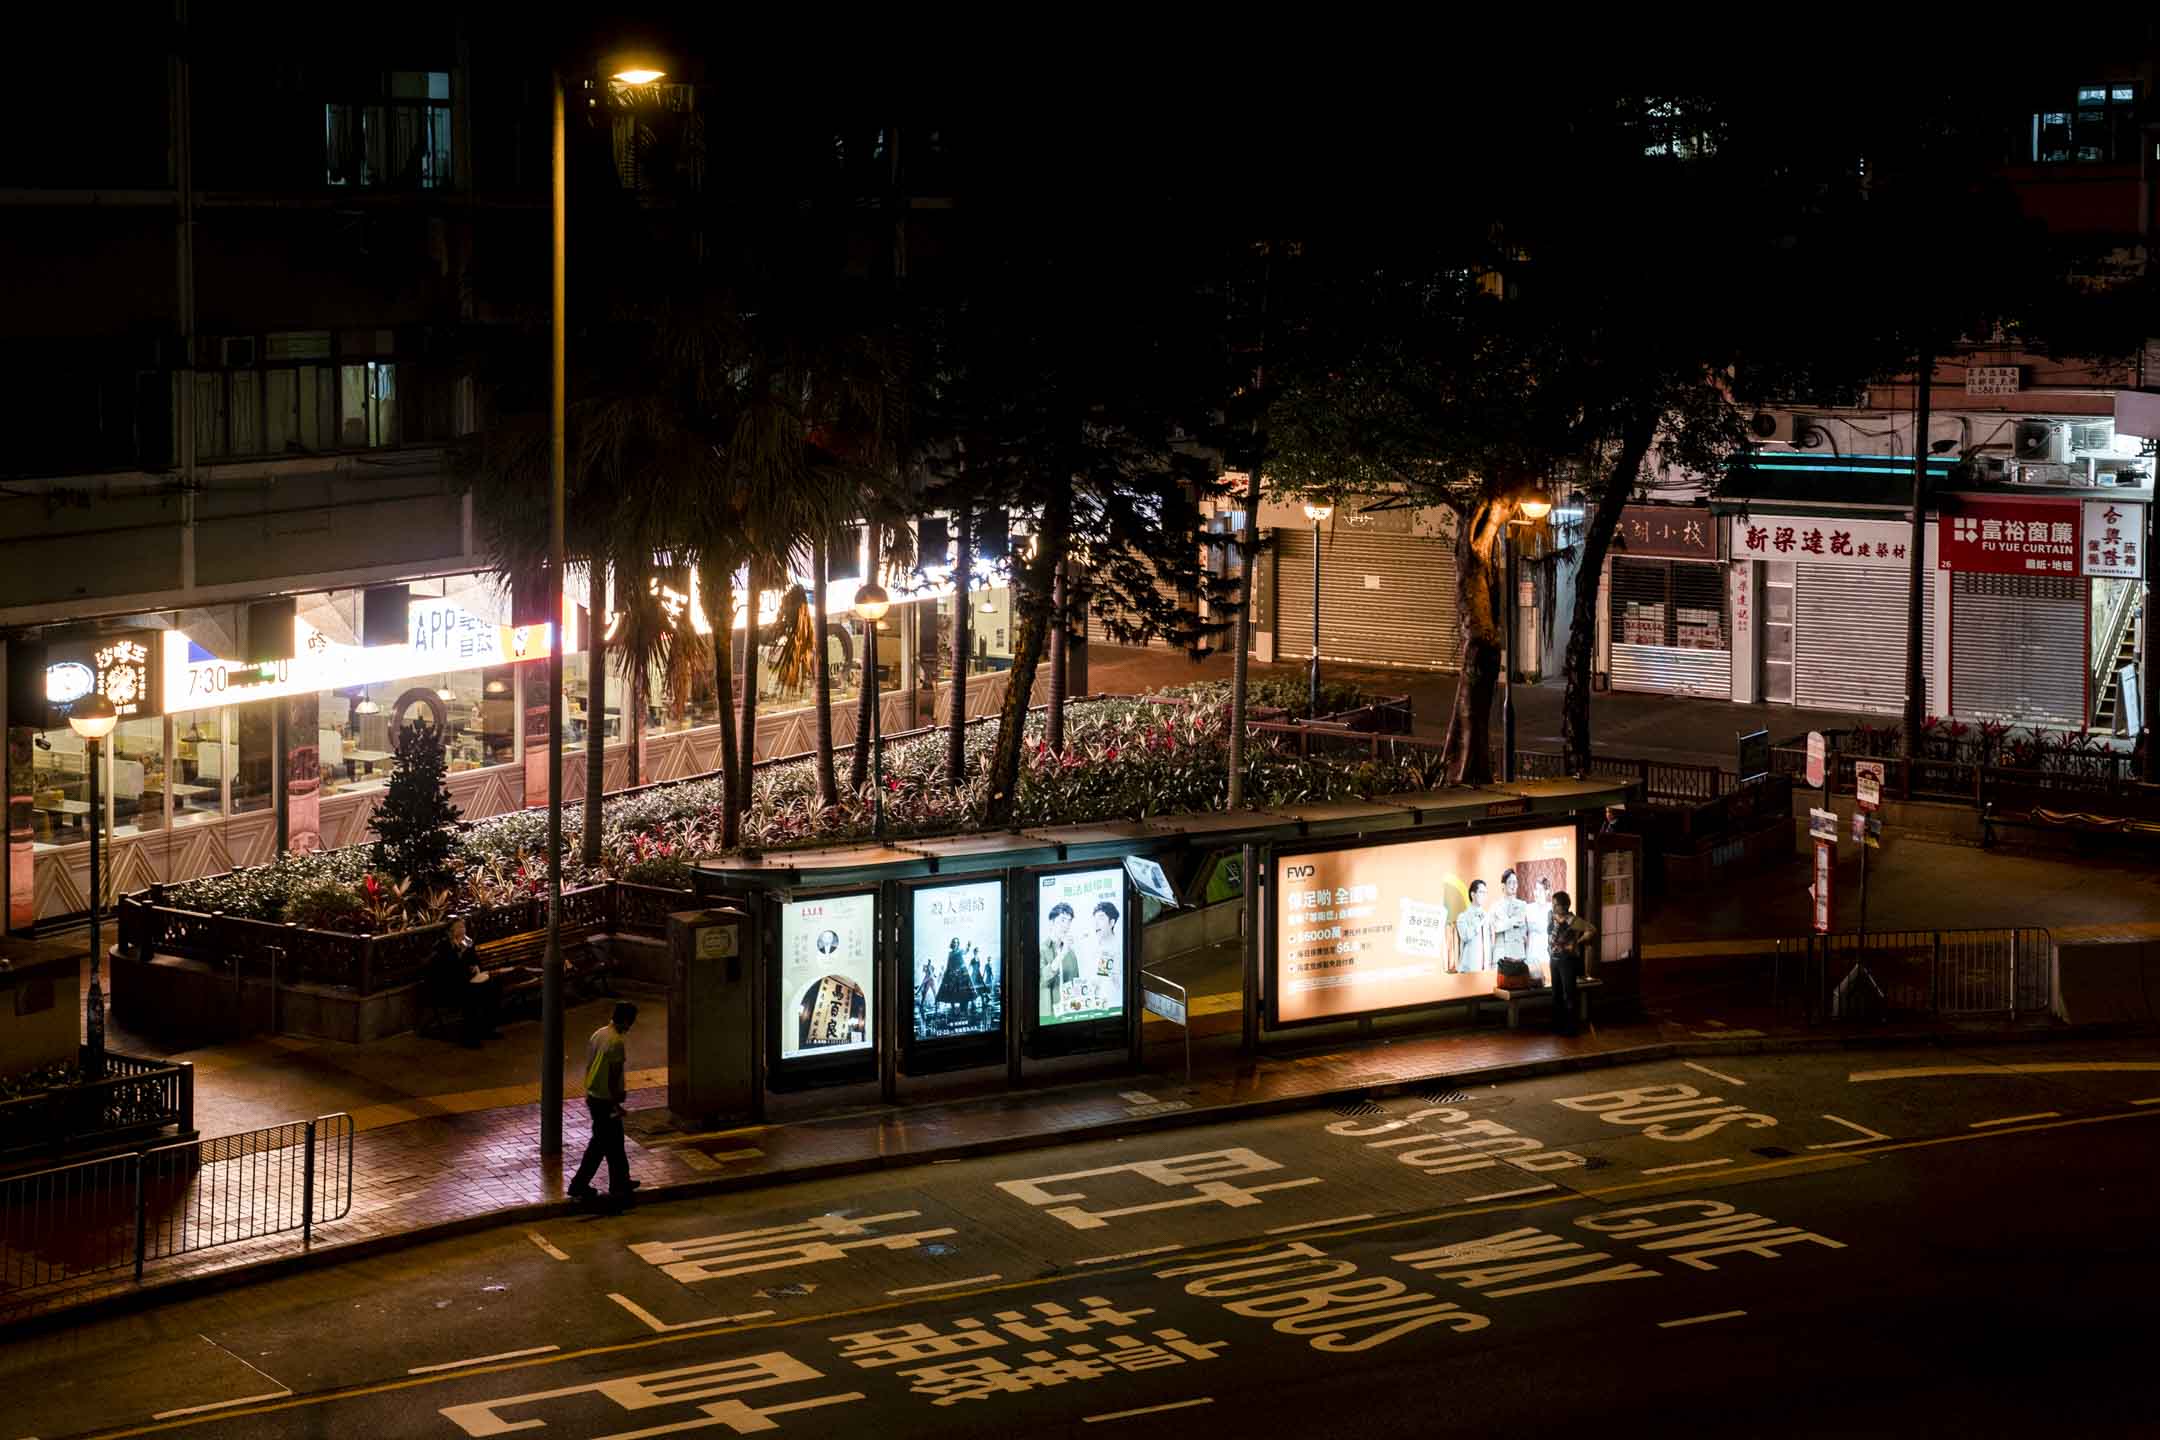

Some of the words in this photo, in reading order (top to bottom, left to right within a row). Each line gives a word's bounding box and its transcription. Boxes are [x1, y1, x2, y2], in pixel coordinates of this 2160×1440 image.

[1746, 525, 1854, 556] 新梁達記
[1941, 560, 1952, 568] 26
[1982, 542, 1996, 551] FU
[1999, 542, 2020, 552] YUE
[2023, 544, 2073, 555] CURTAIN
[416, 608, 456, 651] APP
[1288, 865, 1315, 879] FWD
[826, 984, 843, 1039] 馬百良
[1325, 1107, 1590, 1175] STOP
[1551, 1083, 1779, 1143] BUS
[995, 1146, 1323, 1230] 巴士
[627, 1209, 957, 1284] 站
[1391, 1226, 1664, 1298] WAY
[1573, 1199, 1849, 1271] GIVE
[828, 1295, 1231, 1407] 請讓
